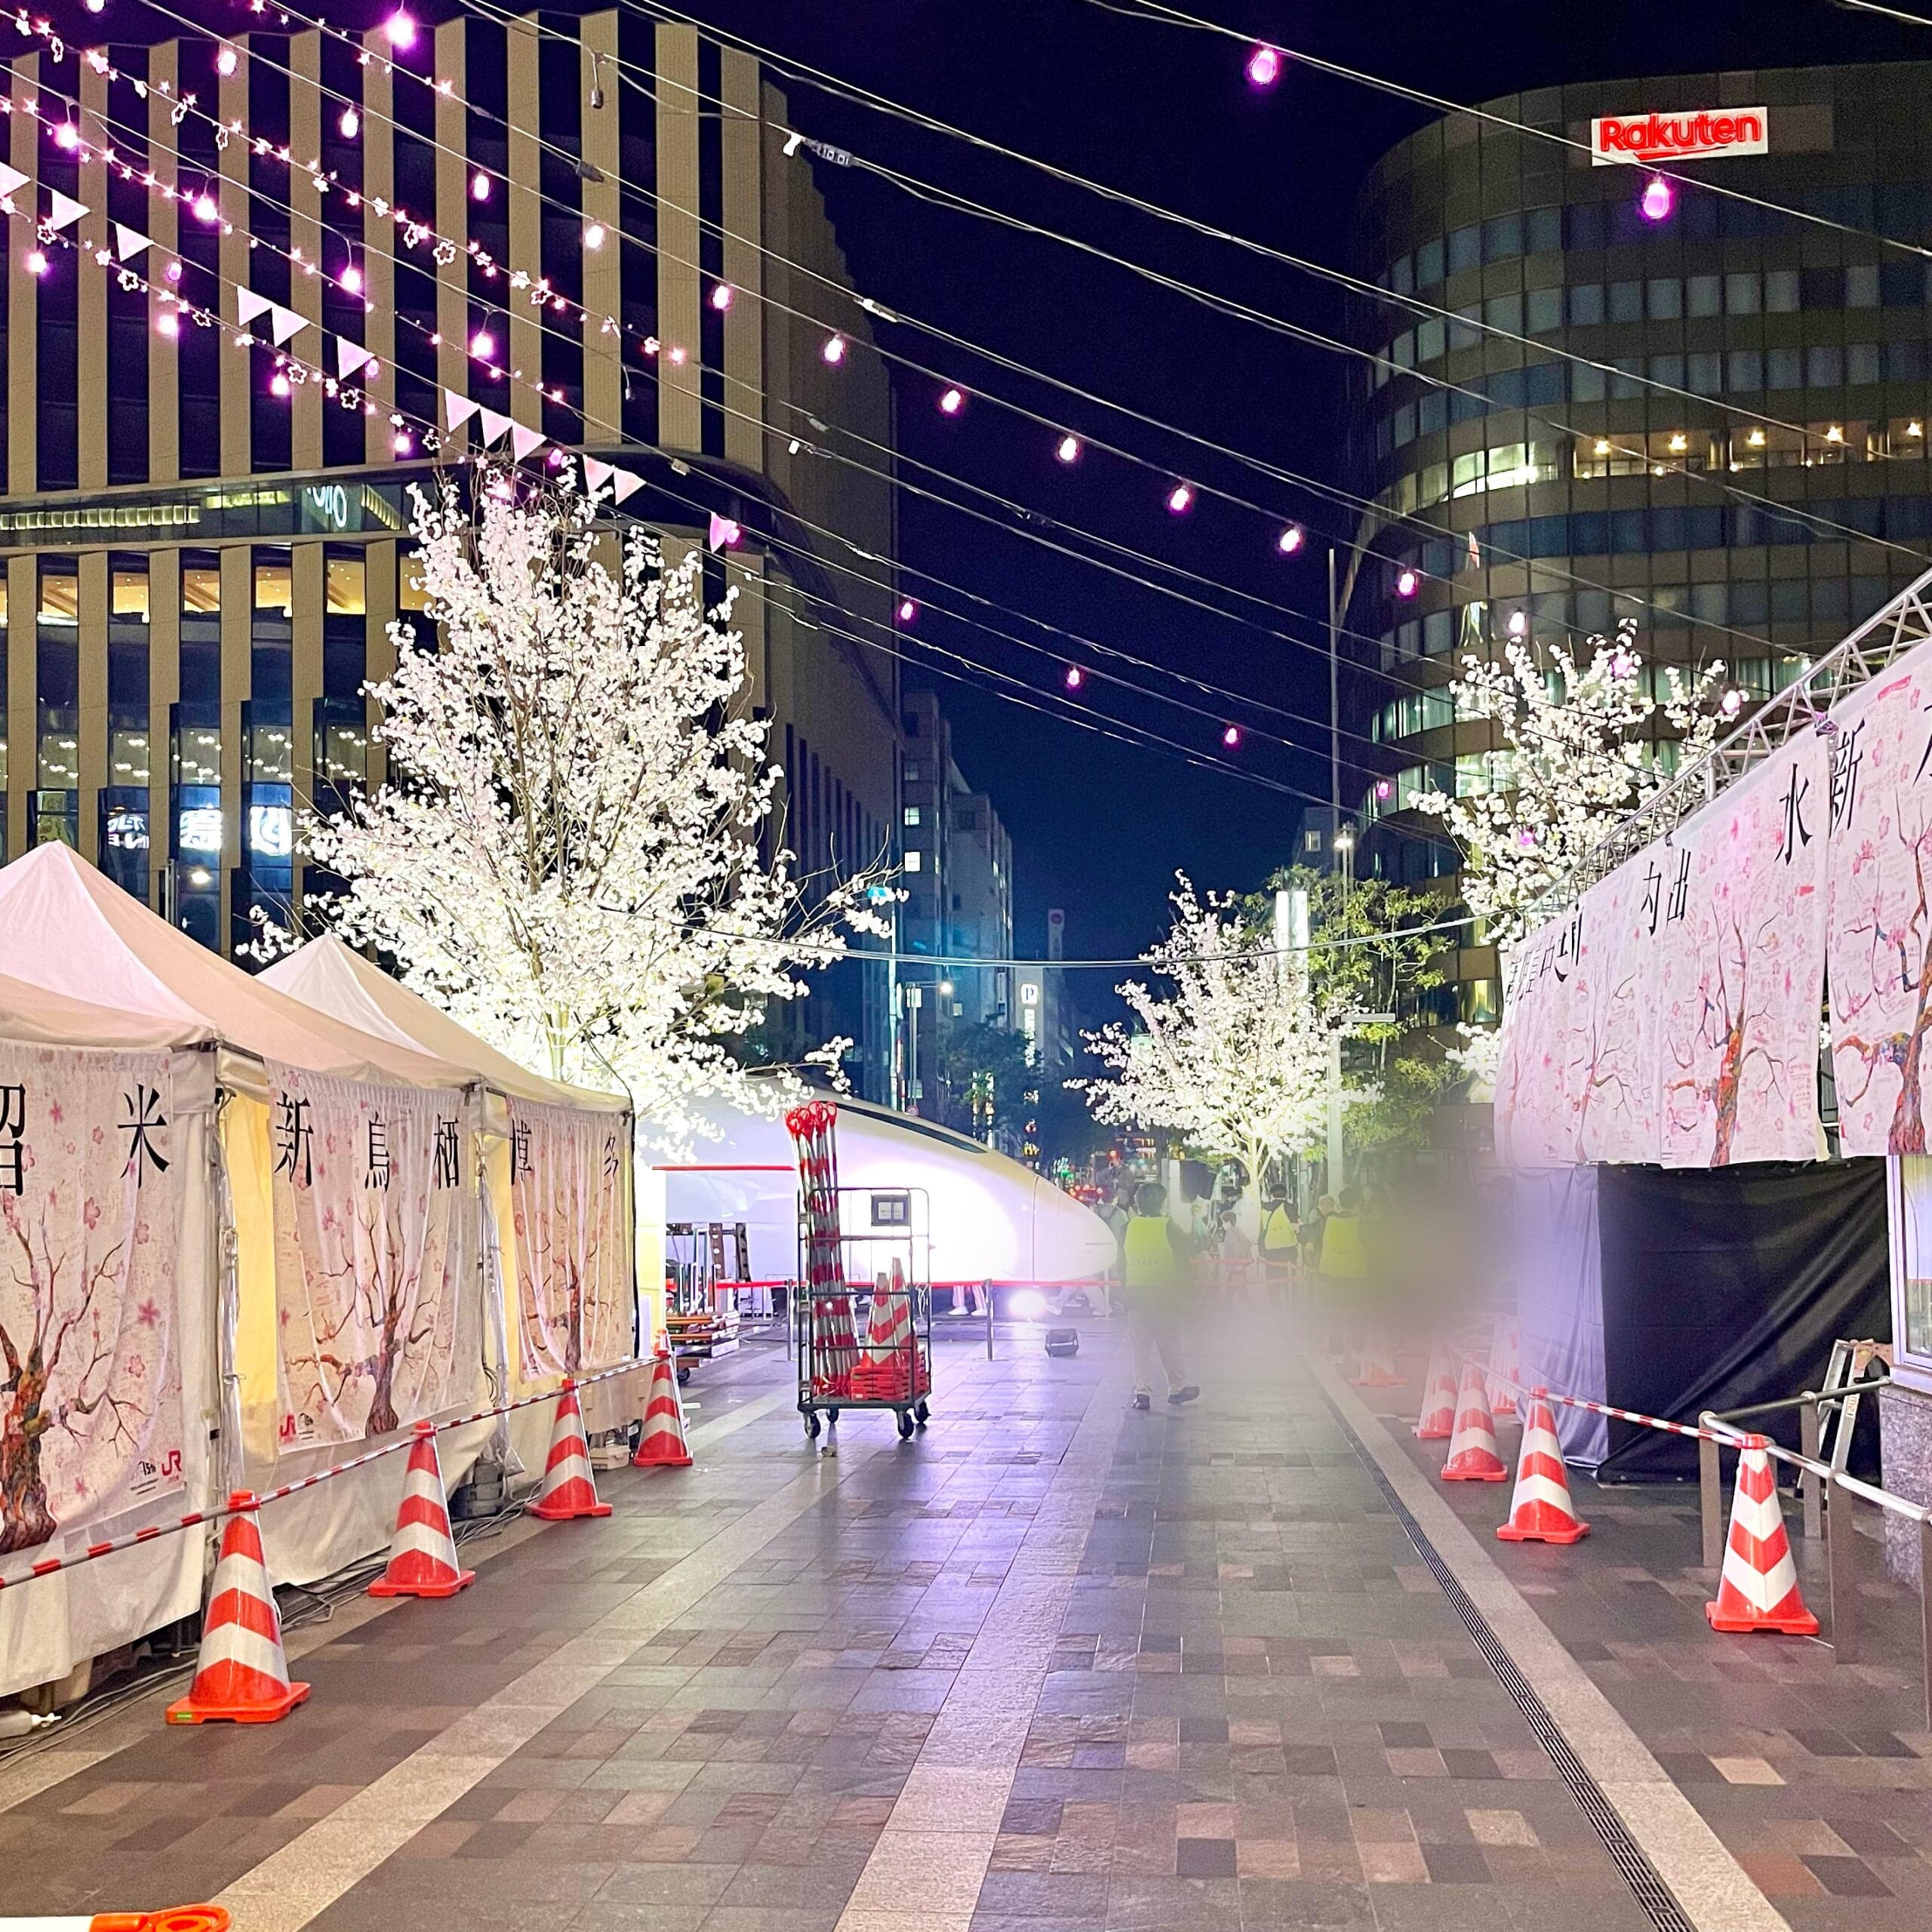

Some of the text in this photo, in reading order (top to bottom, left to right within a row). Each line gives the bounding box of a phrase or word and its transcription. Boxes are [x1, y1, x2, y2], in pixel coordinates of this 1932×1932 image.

[1600, 112, 1761, 152] Rakuten
[274, 1091, 459, 1193] 新鳥栖
[162, 1450, 182, 1475] JR
